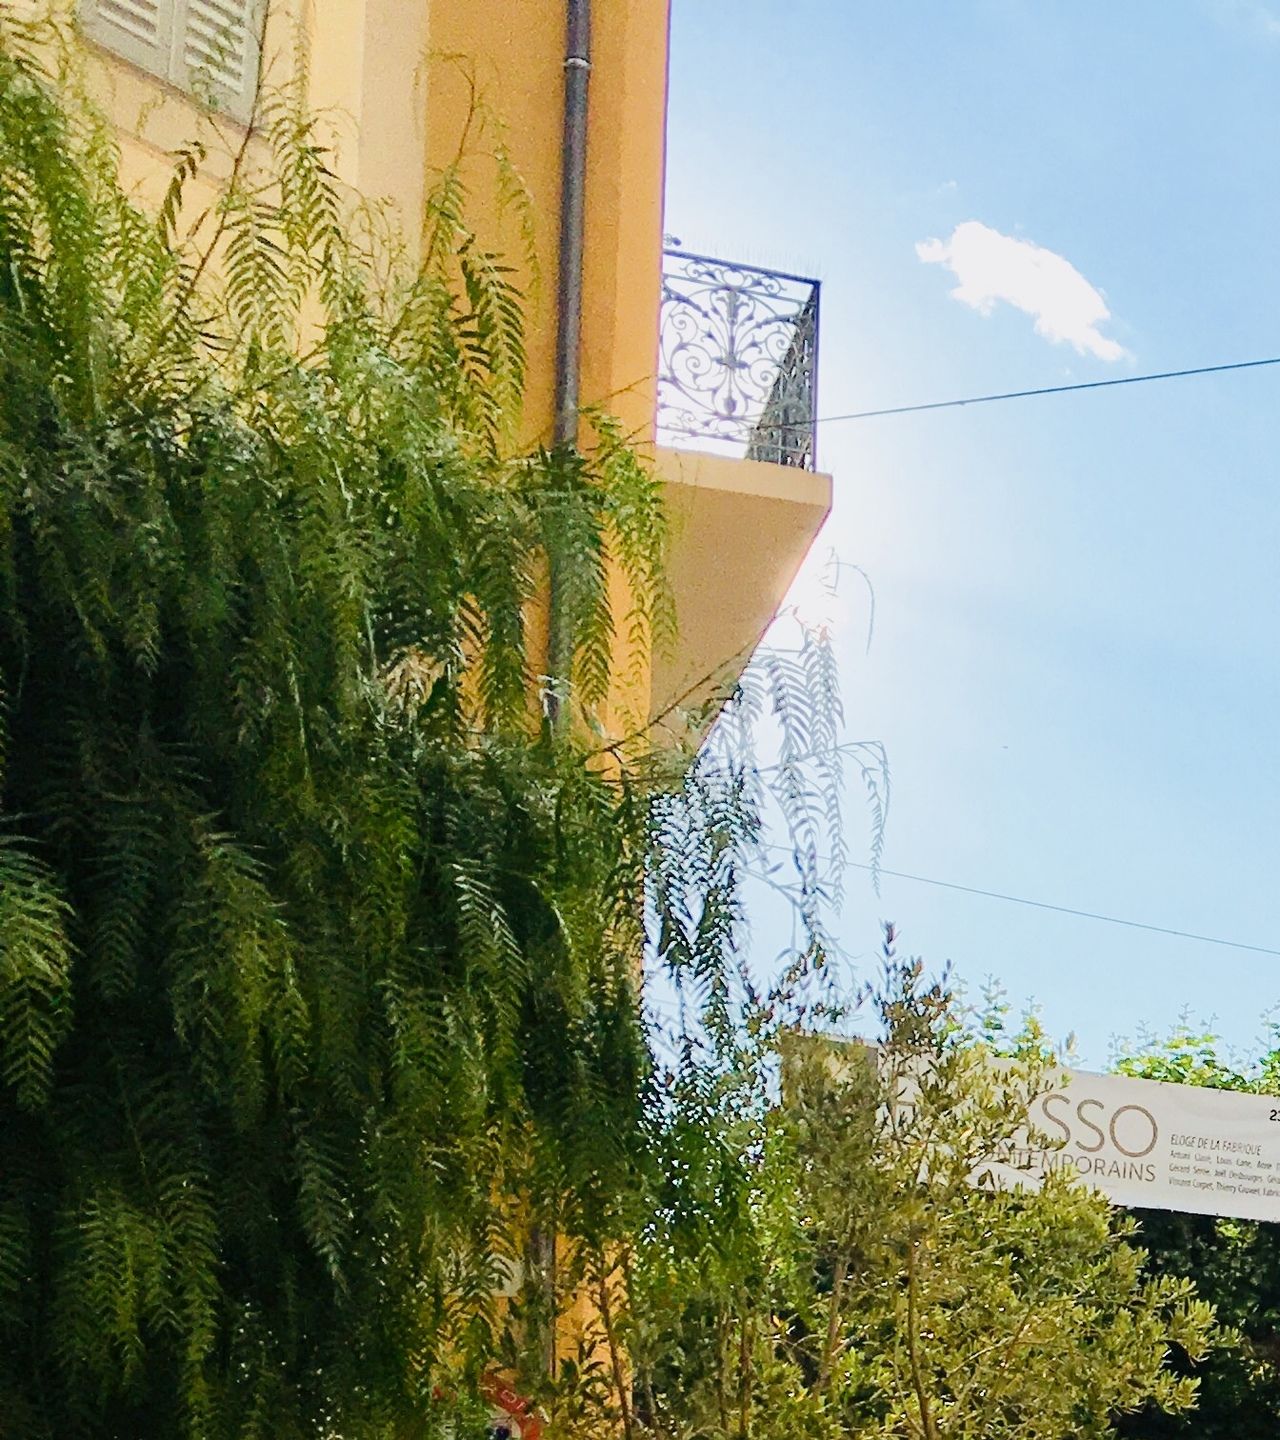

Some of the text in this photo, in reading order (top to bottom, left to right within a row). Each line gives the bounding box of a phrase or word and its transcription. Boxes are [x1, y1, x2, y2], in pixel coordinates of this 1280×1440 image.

[1197, 1138, 1208, 1149] DE
[1210, 1140, 1220, 1151] LA
[1222, 1142, 1262, 1156] FABRIQUE
